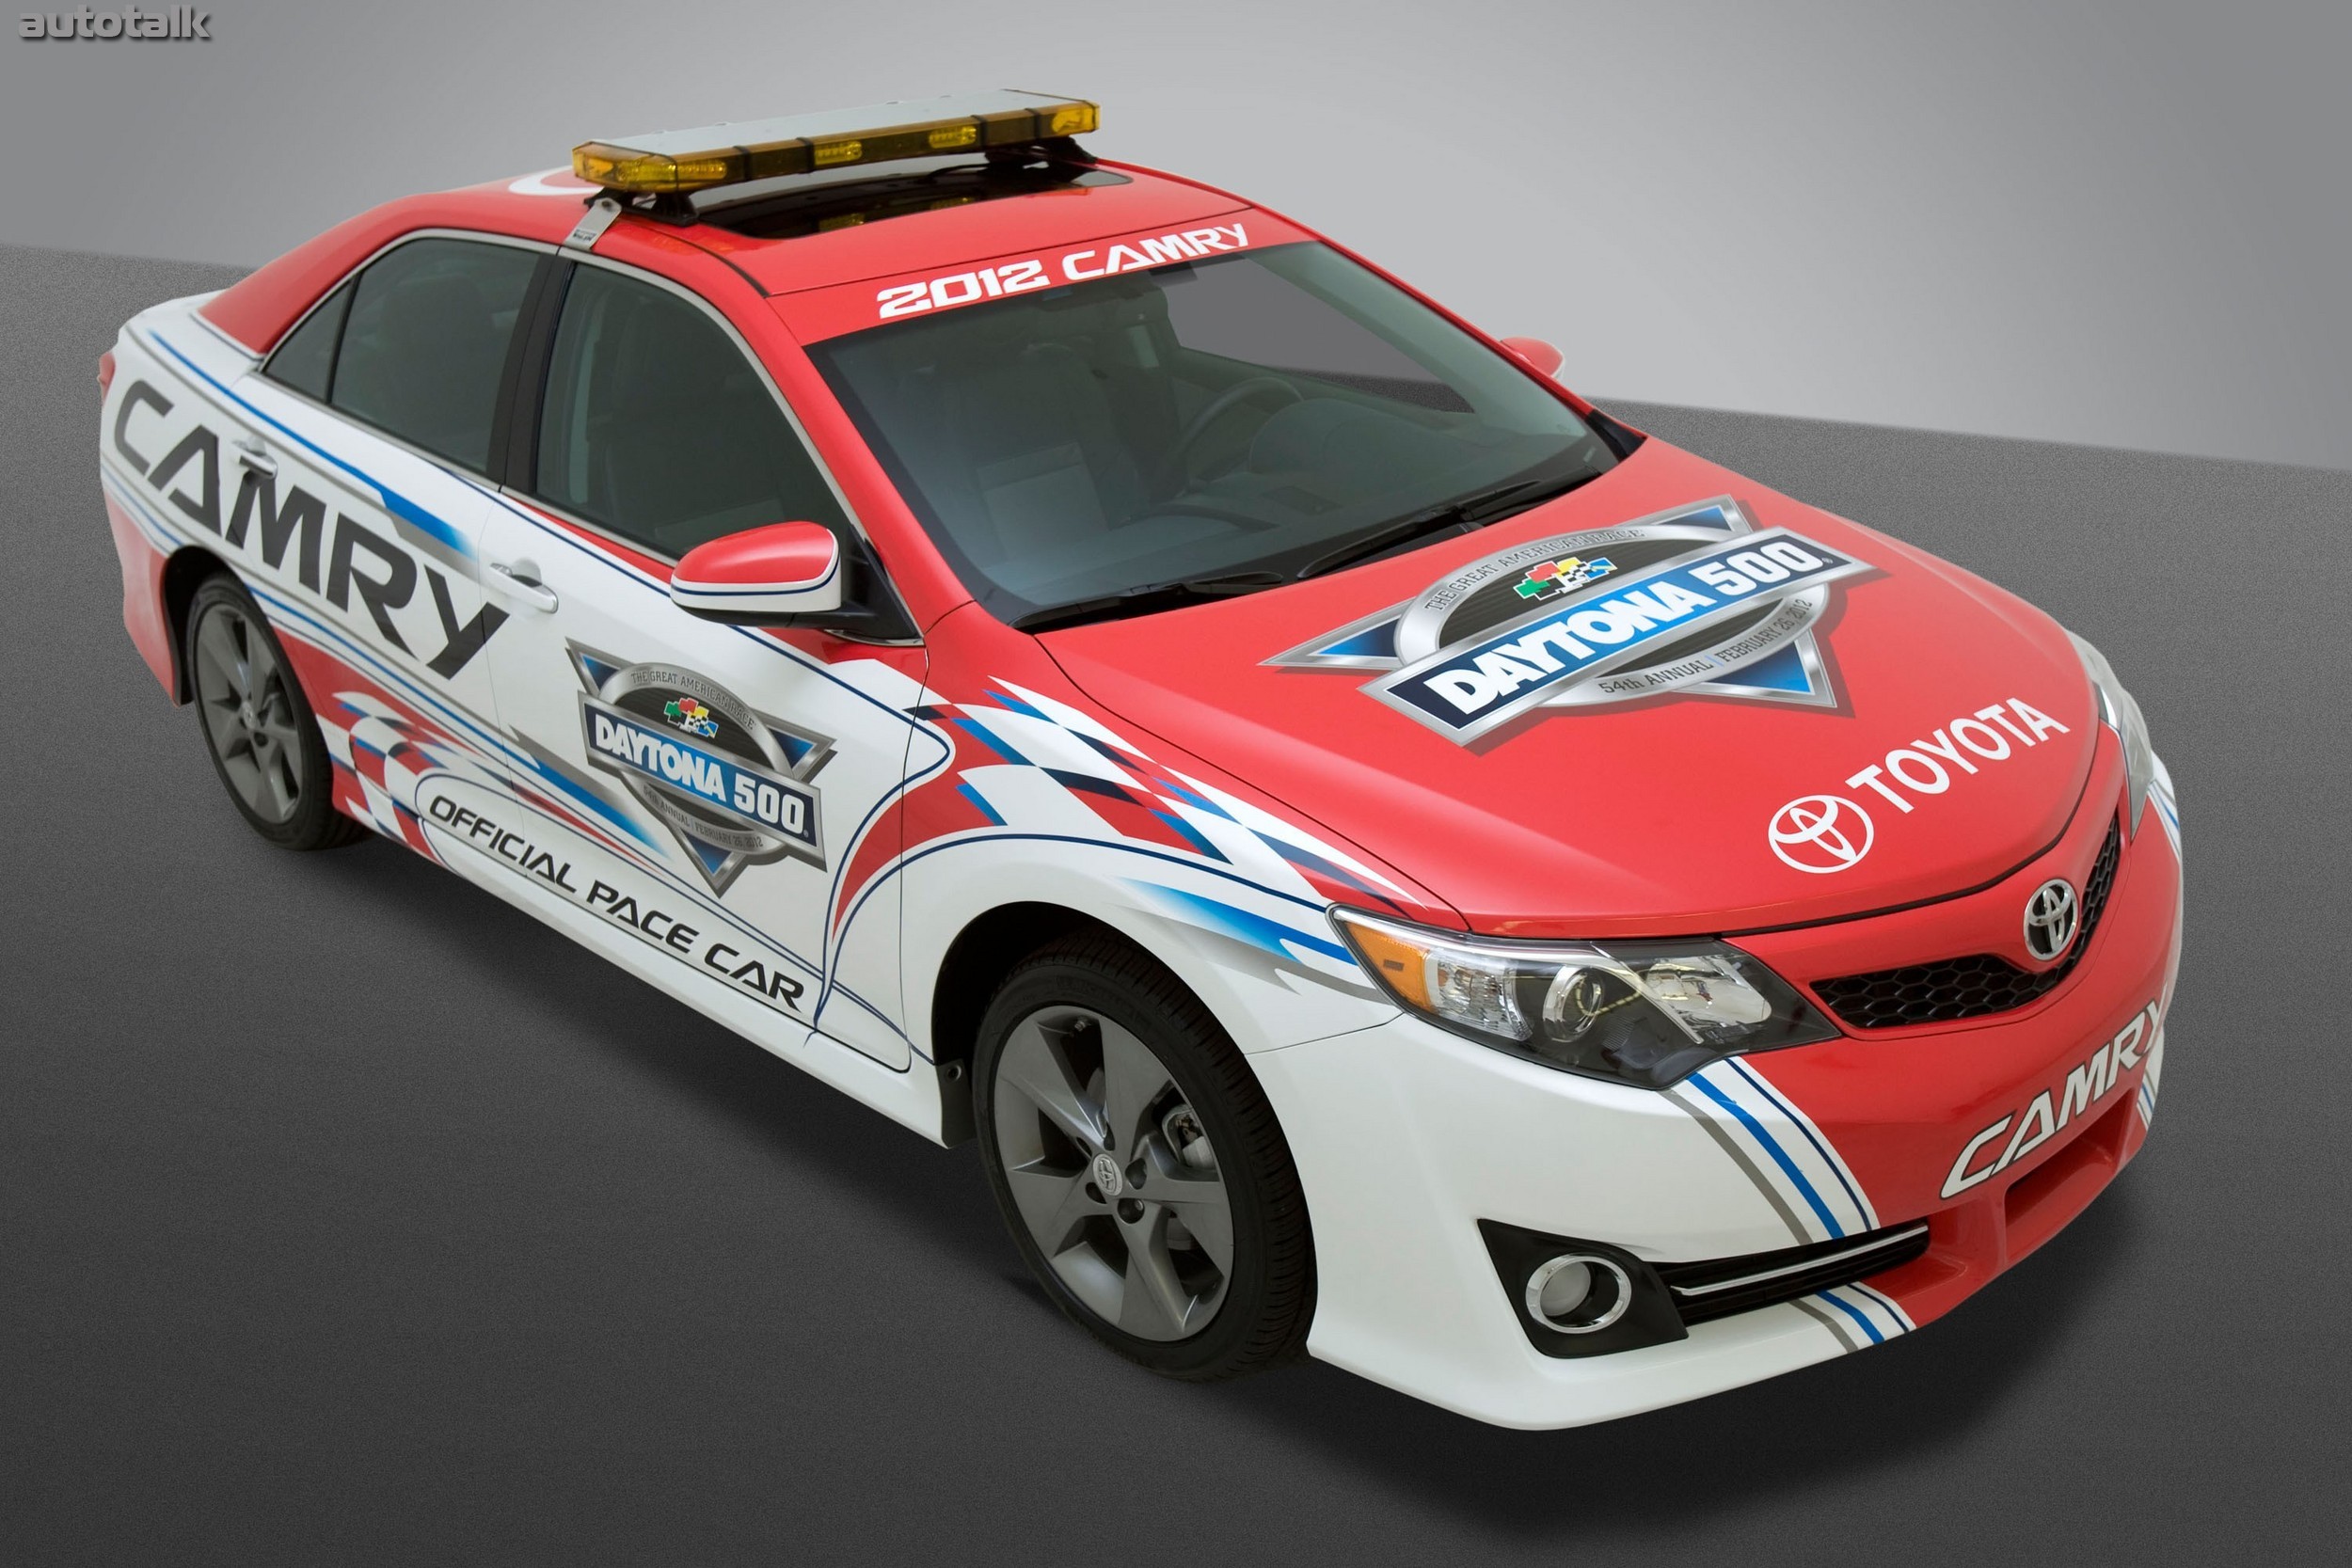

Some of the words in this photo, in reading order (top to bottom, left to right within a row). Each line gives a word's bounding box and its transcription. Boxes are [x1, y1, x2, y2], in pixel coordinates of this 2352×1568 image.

[876, 259, 1051, 319] 2012
[1061, 223, 1249, 281] CAMRY
[114, 379, 511, 681] CAMRY
[1424, 590, 1456, 611] THE
[1449, 563, 1499, 592] GREAT
[1498, 533, 1592, 568] AMERICAN
[1590, 528, 1645, 544] RACE
[1422, 580, 1718, 715] DAYTONA
[1688, 540, 1823, 597] 500
[1598, 678, 1645, 694] 54th
[1645, 659, 1714, 687] ANNUAL
[1713, 626, 1783, 663] FEBRUARY
[1786, 598, 1813, 620] 2012
[630, 671, 648, 684] THE
[648, 671, 678, 685] GREAT
[680, 676, 730, 712] AMERICAN
[595, 713, 727, 803] DAYTONA
[733, 772, 805, 835] 500
[1844, 697, 2071, 815] TOYOTA
[660, 800, 691, 828] ANNUAL
[694, 821, 733, 845] FEBRUARY
[429, 794, 578, 894] OFFICIAL
[586, 879, 700, 955] PACE
[704, 942, 805, 1013] CAR
